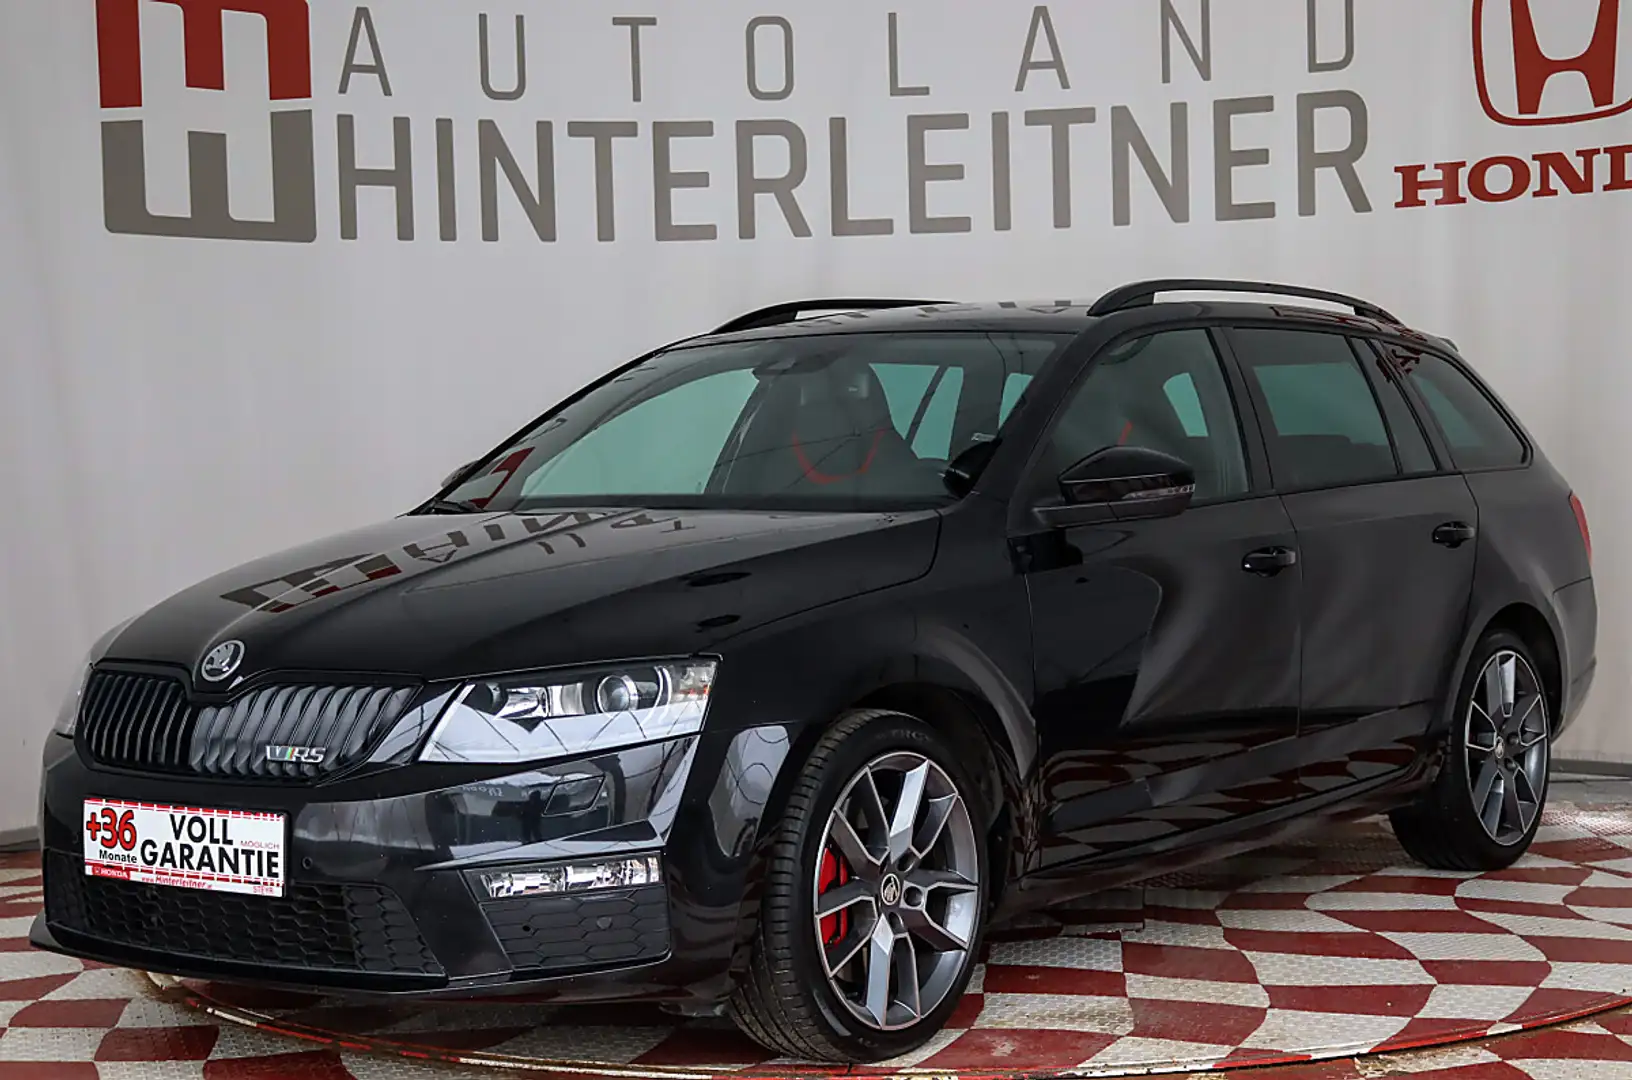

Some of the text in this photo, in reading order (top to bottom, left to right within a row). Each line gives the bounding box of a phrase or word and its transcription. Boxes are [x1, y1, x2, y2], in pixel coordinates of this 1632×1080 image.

[337, 90, 1373, 243] HINTERLEITNER
[86, 808, 137, 850] +36
[170, 814, 233, 846] VOLL
[100, 849, 138, 864] Monate
[140, 839, 279, 878] GARANTIE
